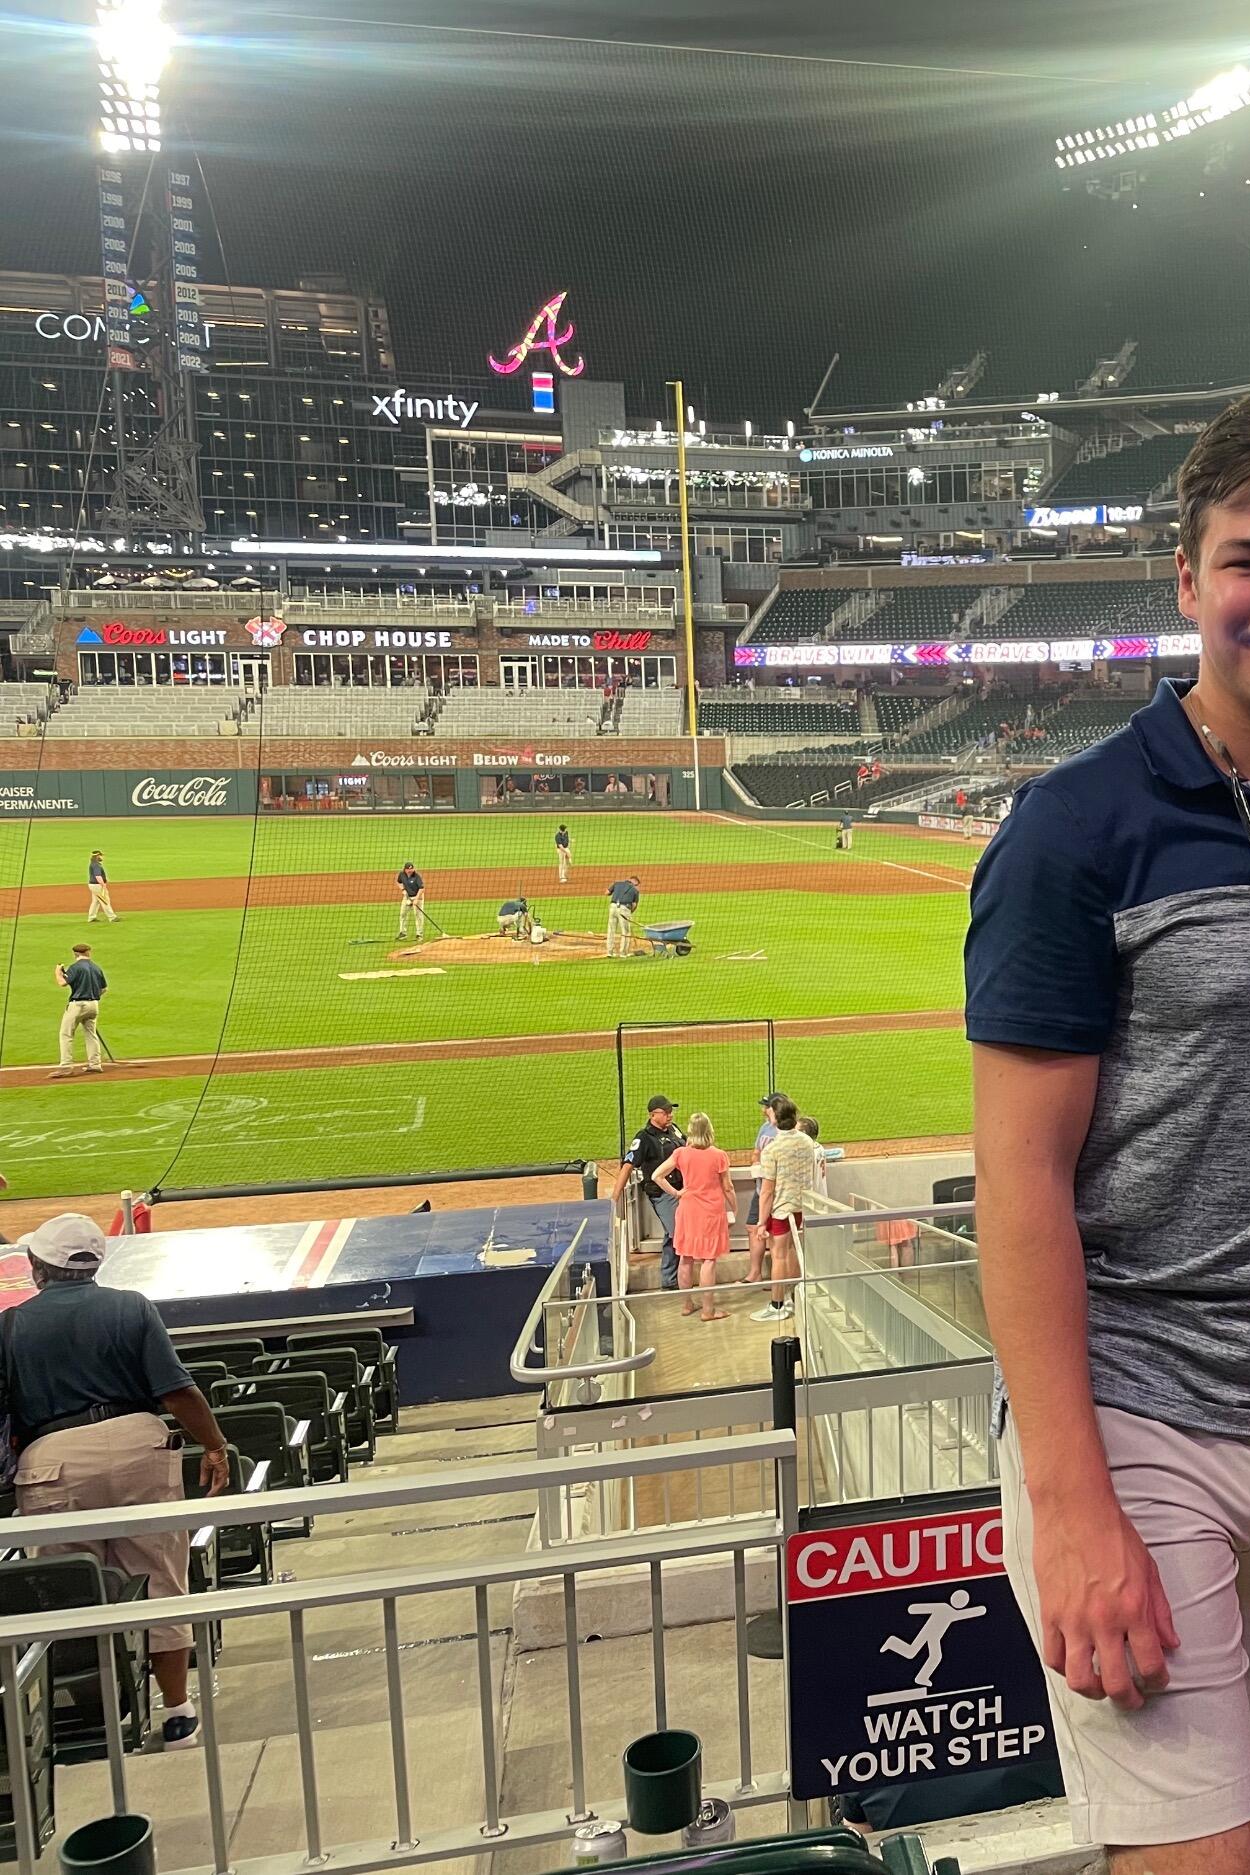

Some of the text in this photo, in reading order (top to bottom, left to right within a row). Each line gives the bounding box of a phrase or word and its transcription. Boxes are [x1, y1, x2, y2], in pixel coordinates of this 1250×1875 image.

[171, 172, 190, 186] 1997
[172, 195, 192, 209] 1999
[173, 218, 193, 233] 2001
[104, 238, 126, 252] 2002
[174, 241, 195, 255] 2003
[105, 261, 127, 275] 2004
[175, 264, 197, 278] 2005
[107, 283, 127, 297] 2010
[177, 287, 197, 300] 2012
[108, 306, 128, 320] 2013
[178, 309, 198, 323] 2018
[109, 329, 129, 343] 2019
[179, 332, 200, 346] 2020
[110, 351, 131, 366] 2021
[180, 354, 200, 368] 2022
[371, 388, 479, 428] xfinity
[813, 446, 894, 460] KONICA MINOLTA
[102, 622, 227, 645] Coors LIGHT
[303, 629, 452, 648] CHOP HOUSE
[528, 630, 652, 651] MADE TO Chill
[766, 646, 839, 665] BRAVES
[971, 641, 1049, 663] BRAVES
[369, 750, 457, 767] Coors LIGHT
[682, 770, 695, 779] 325
[132, 776, 231, 807] Coca-Cola
[797, 1518, 1003, 1588] CAUTIO
[864, 1696, 1002, 1744] WATCH
[821, 1725, 1045, 1786] YOUR STEP
